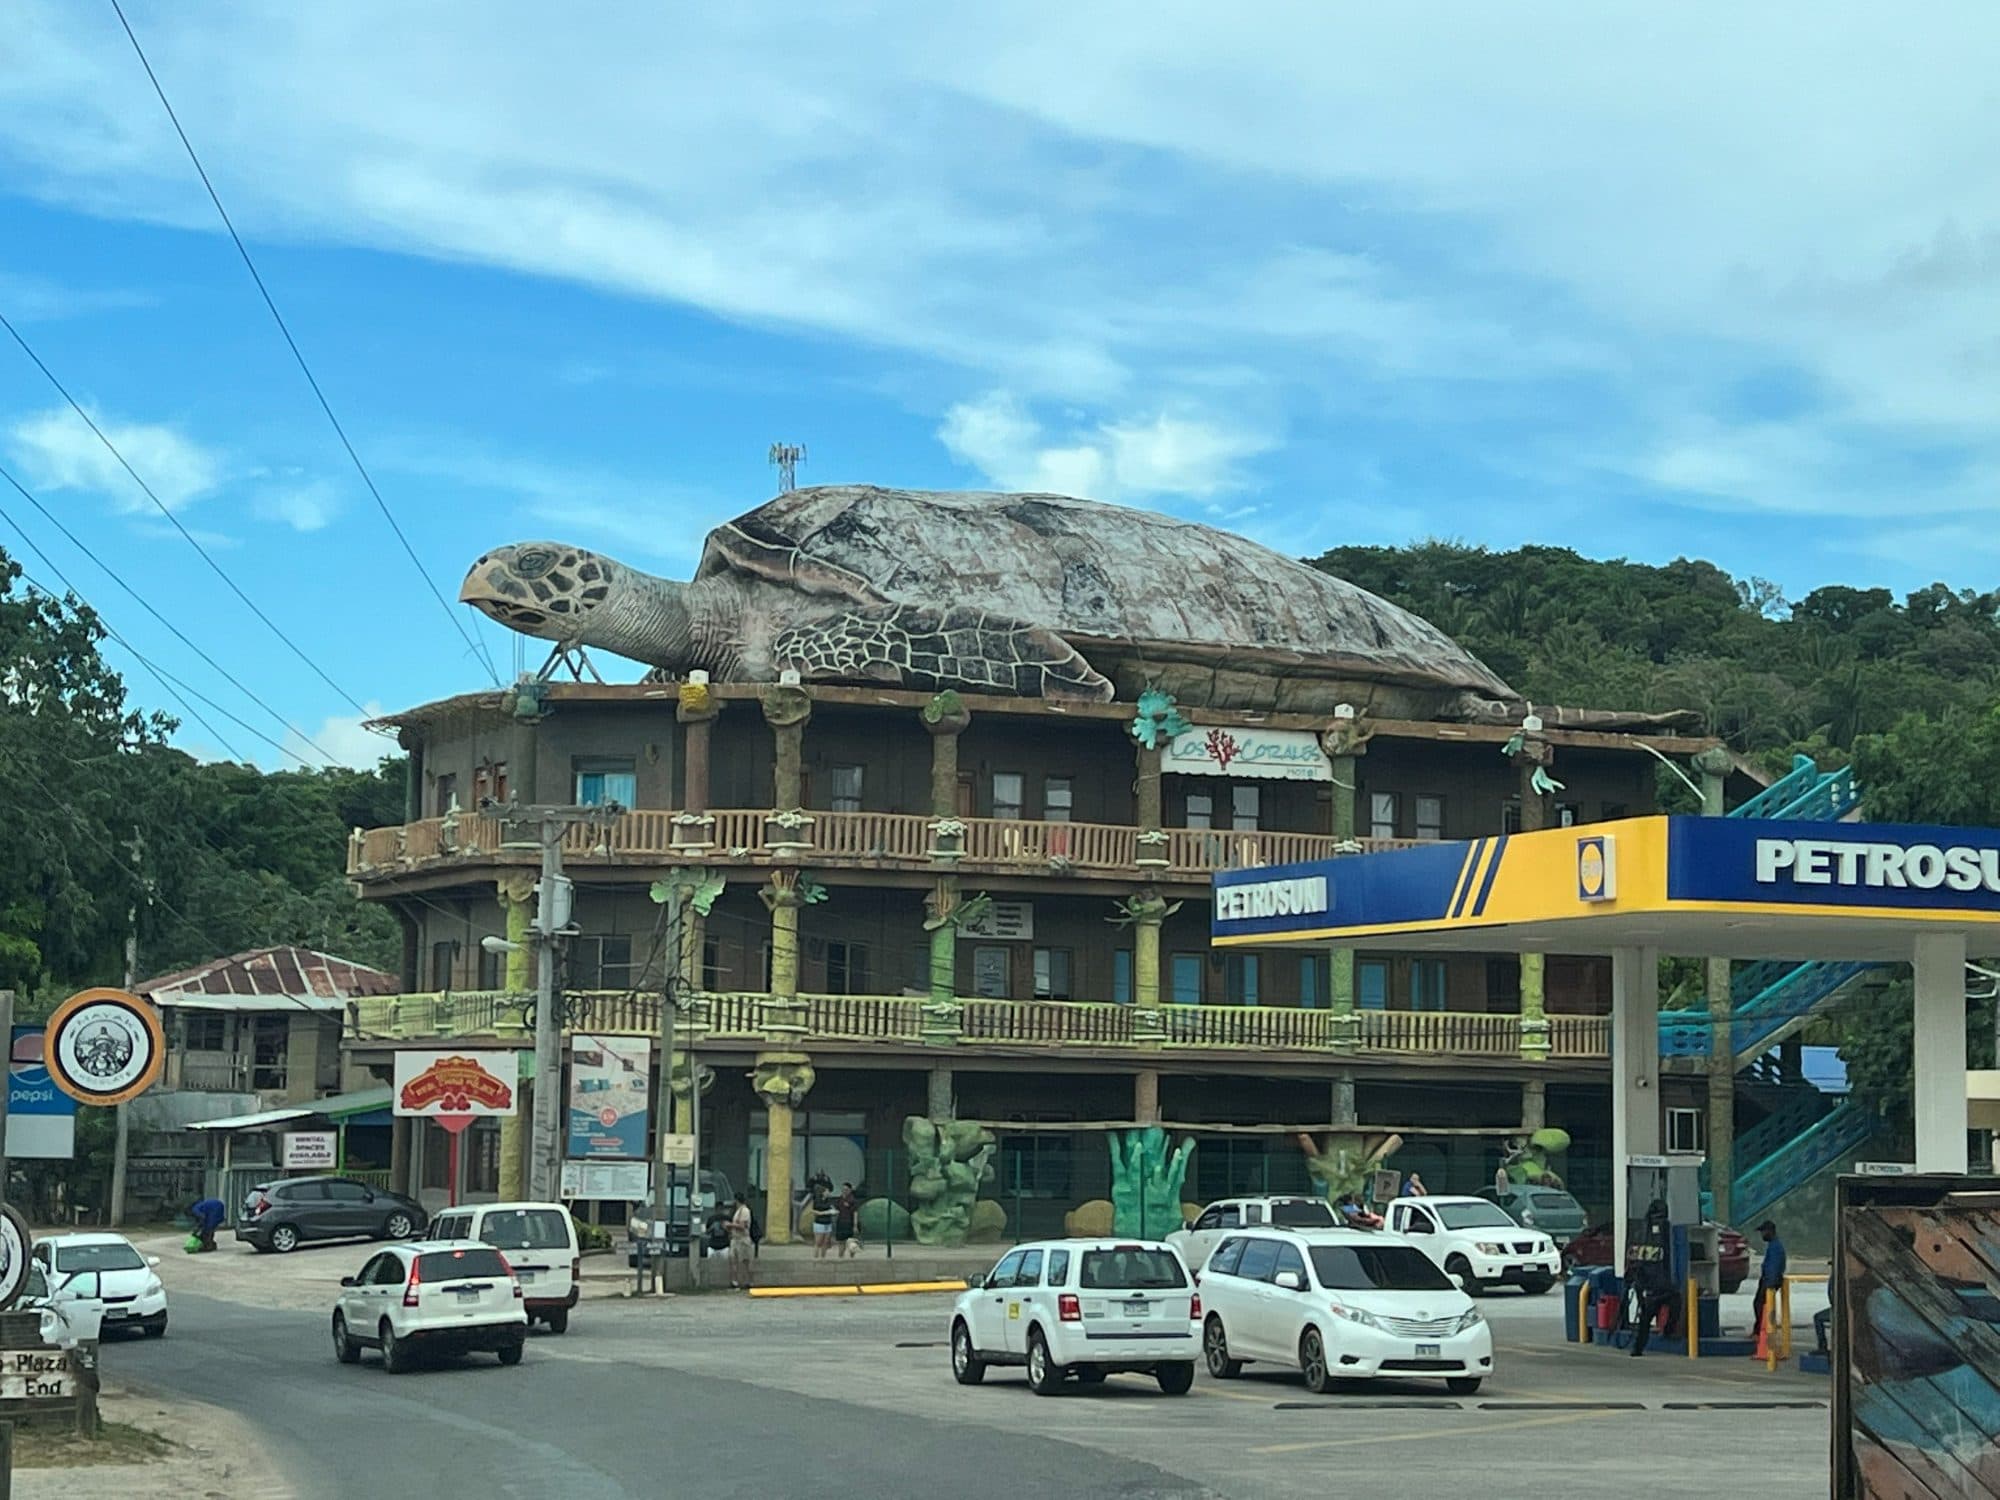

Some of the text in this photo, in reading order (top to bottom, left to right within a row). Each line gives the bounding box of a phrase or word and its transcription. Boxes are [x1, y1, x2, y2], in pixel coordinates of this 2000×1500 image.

[1217, 876, 1327, 921] PETROSUN
[10, 1089, 54, 1104] pepsi
[16, 1354, 68, 1373] Plaza
[25, 1378, 62, 1396] End
